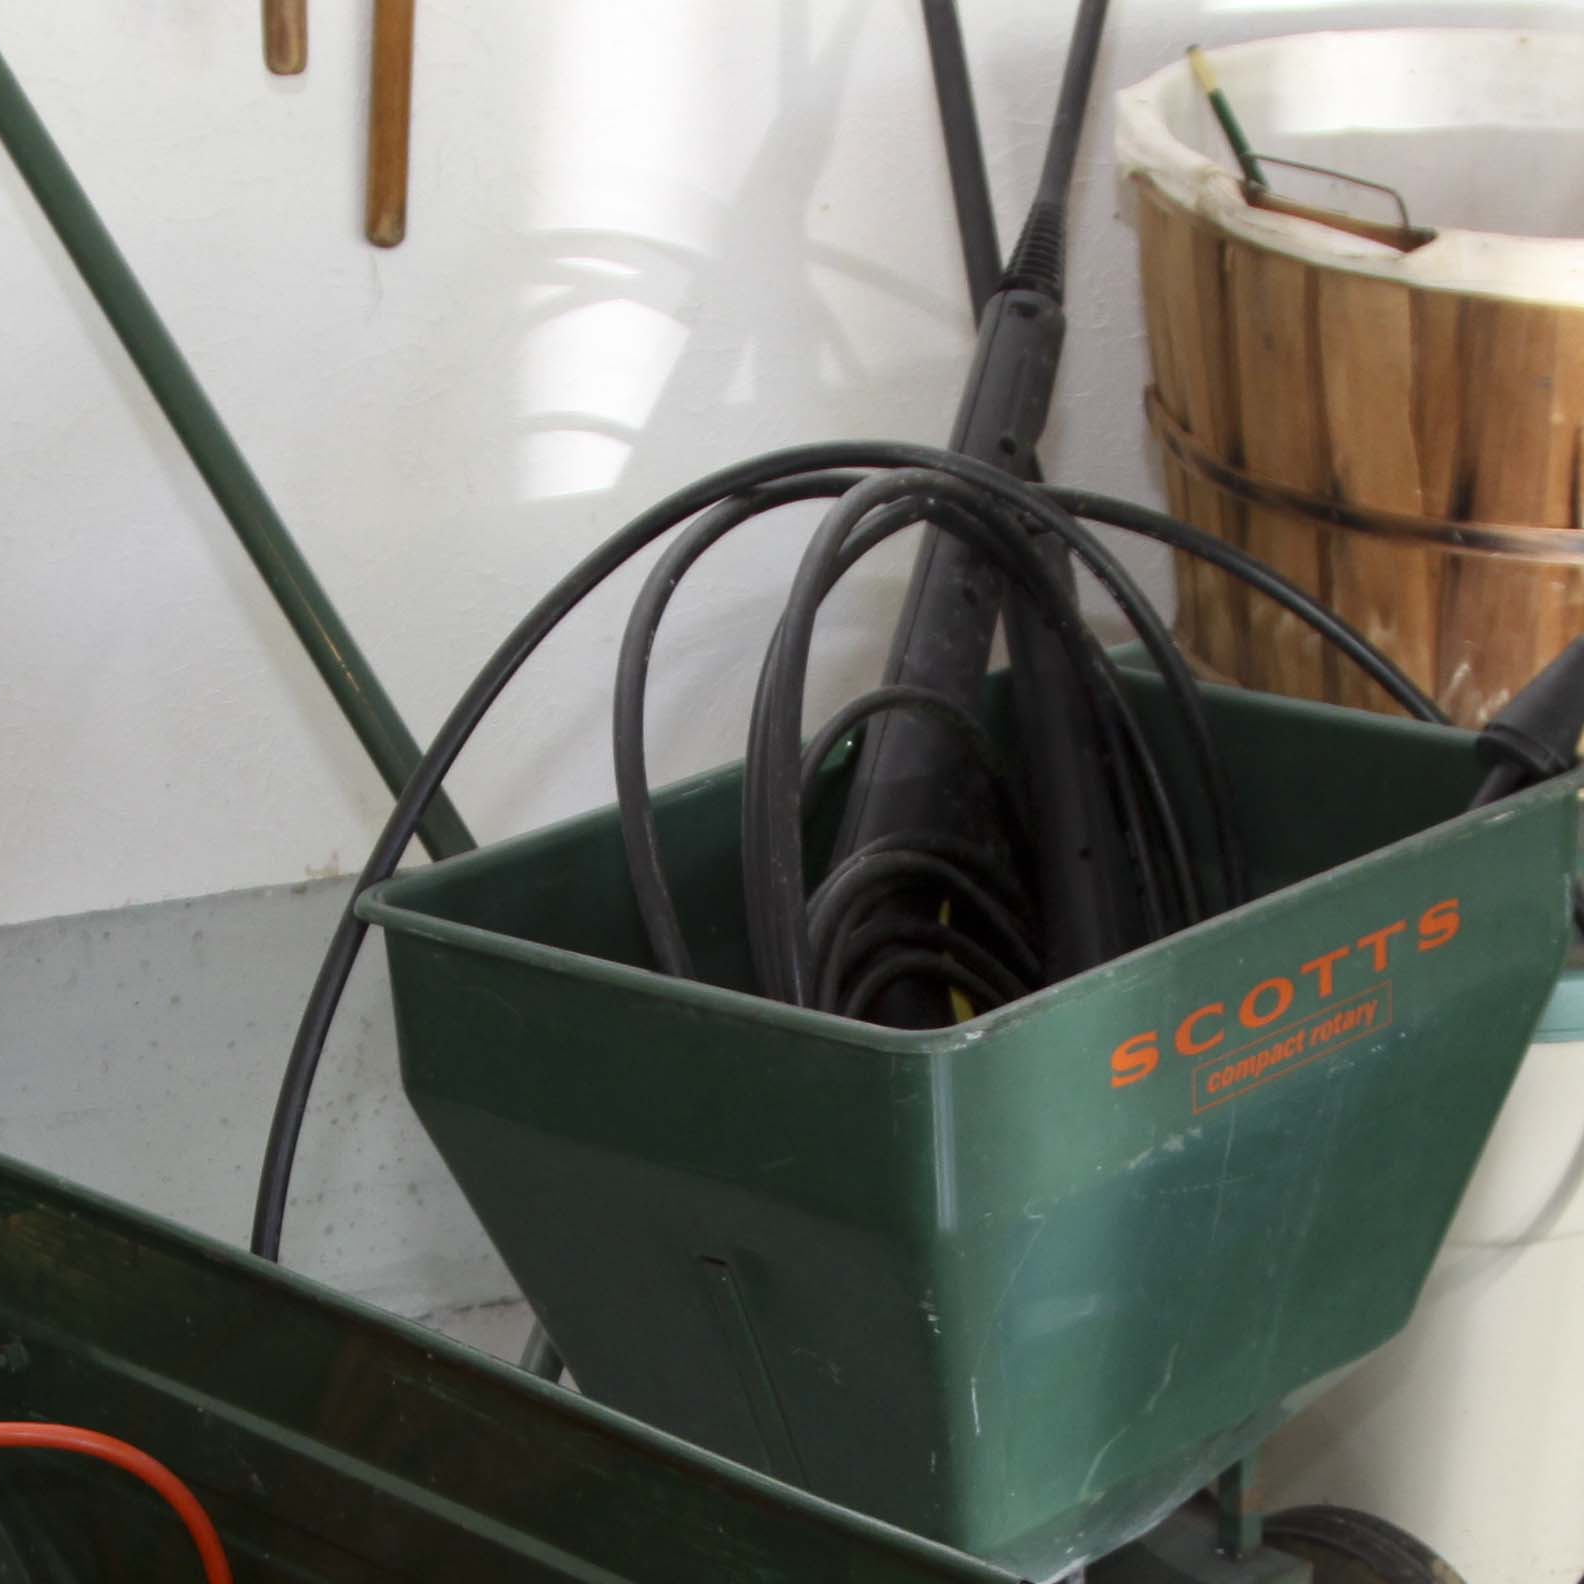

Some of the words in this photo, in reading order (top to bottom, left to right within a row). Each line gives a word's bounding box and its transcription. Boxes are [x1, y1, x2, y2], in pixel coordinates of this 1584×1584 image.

[1110, 898, 1460, 1087] SCOTTS
[1206, 1030, 1306, 1094] compact
[1310, 998, 1378, 1046] rotary
